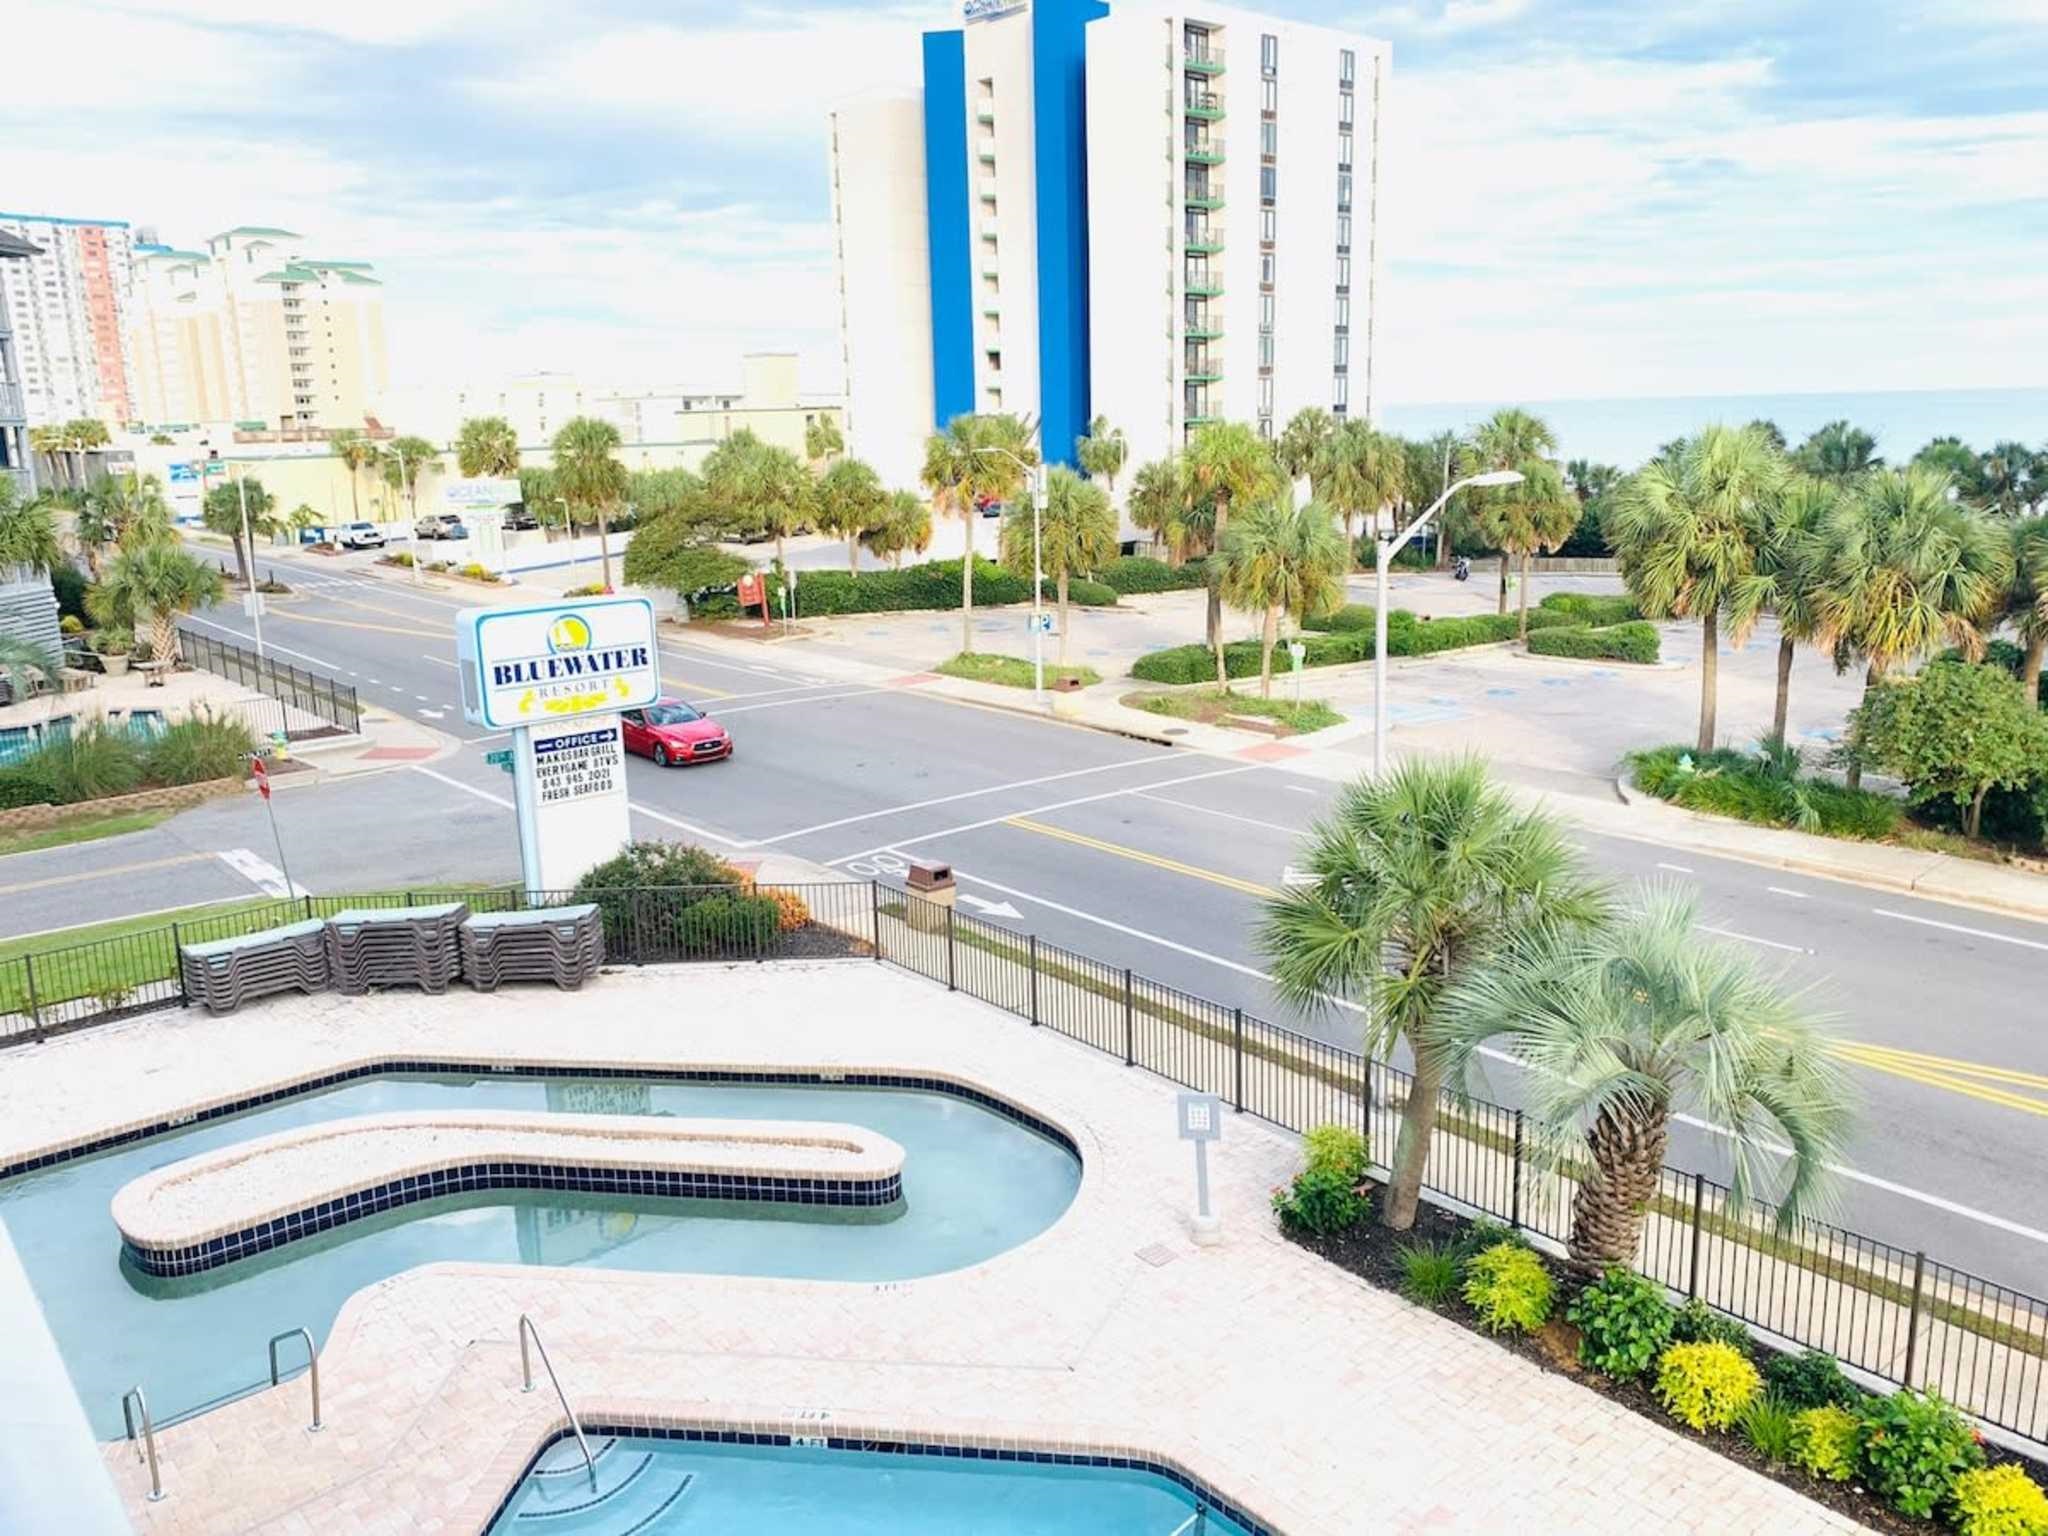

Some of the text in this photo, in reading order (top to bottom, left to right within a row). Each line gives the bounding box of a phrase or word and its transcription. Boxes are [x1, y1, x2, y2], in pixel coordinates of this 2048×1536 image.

[494, 648, 647, 685] BLUEWATER
[539, 680, 609, 698] RESORT
[555, 733, 597, 748] OFFICE
[589, 769, 610, 781] 2021
[542, 780, 612, 801] FRESH SEAFOOD
